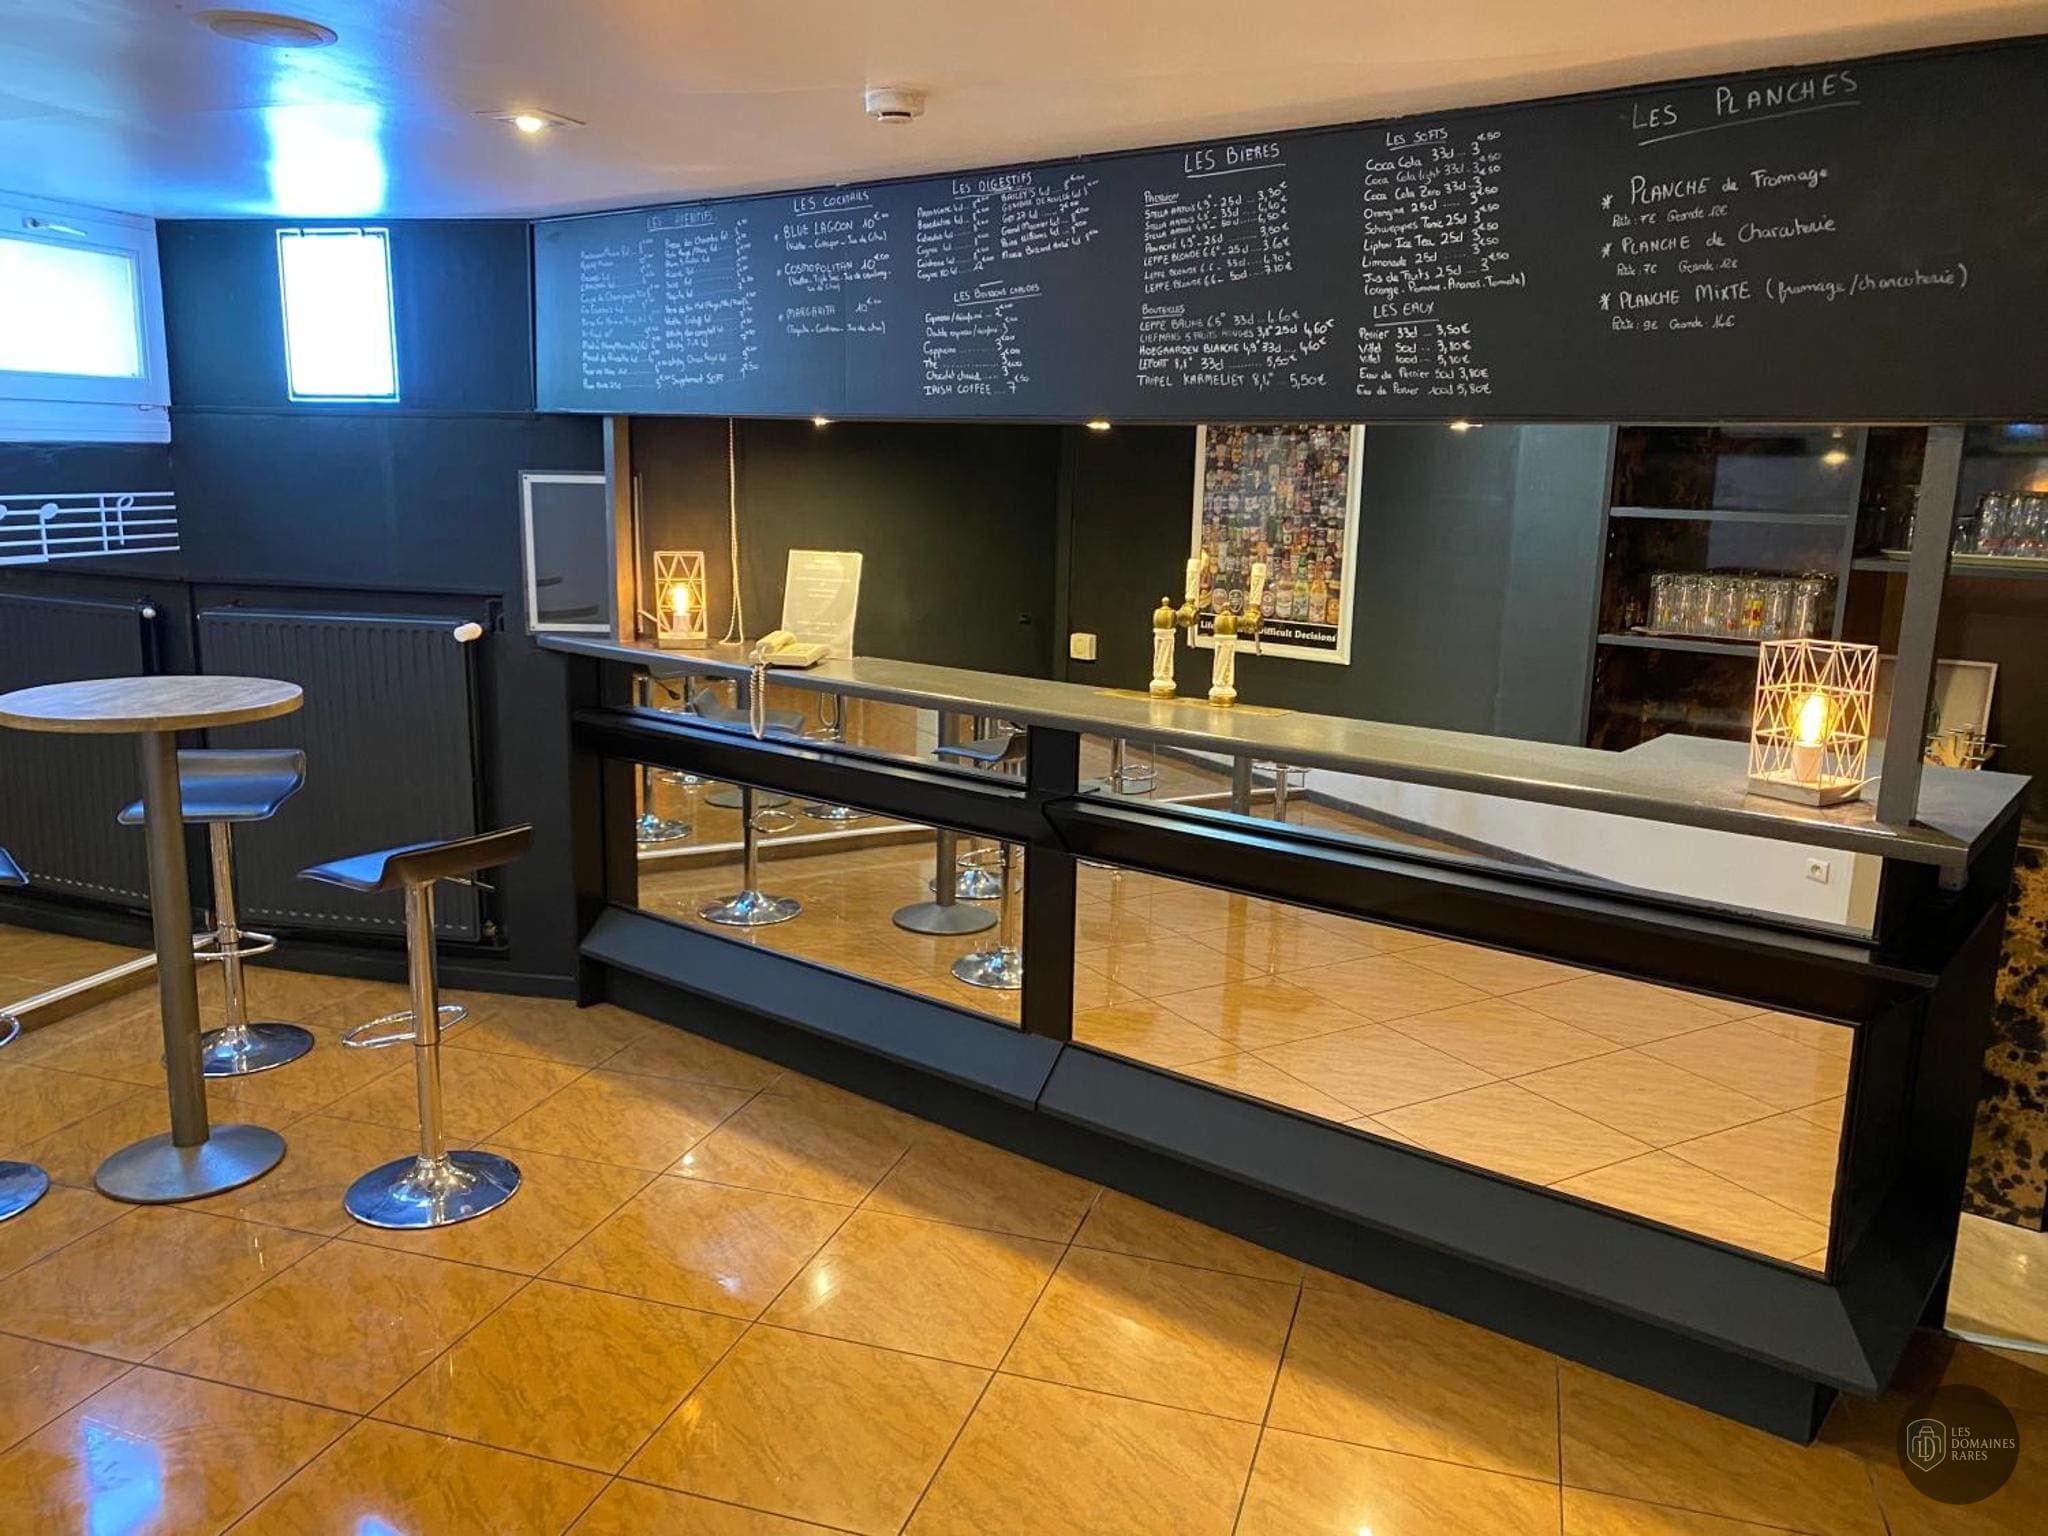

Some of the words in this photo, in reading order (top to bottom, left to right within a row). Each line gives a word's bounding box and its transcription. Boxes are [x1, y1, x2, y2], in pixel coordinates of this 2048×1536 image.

[1632, 103, 1678, 129] LES
[1716, 71, 1858, 115] PLANCHES
[1386, 132, 1405, 146] LES
[1413, 128, 1448, 142] SOFTS
[1184, 150, 1215, 173] LES
[1366, 159, 1396, 172] Coca
[1398, 156, 1422, 168] Cola
[1365, 174, 1390, 186] Coca
[1396, 171, 1417, 182] Cola
[1419, 167, 1441, 184] light
[952, 179, 971, 195] LES
[1363, 189, 1388, 202] Coca
[1395, 187, 1415, 200] Cola
[1631, 175, 1710, 205] PLANCHE
[1722, 178, 1739, 192] de
[1751, 168, 1829, 189] Fromage
[794, 197, 816, 212] LES
[783, 224, 809, 239] BLUE
[814, 220, 853, 236] LAGOON
[1621, 235, 1691, 255] PLANCHE
[1706, 231, 1726, 247] de
[1738, 215, 1837, 244] Charcuterie
[1414, 235, 1435, 247] Tea
[954, 291, 970, 302] LES
[1620, 290, 1680, 310] PLANCHE
[1373, 302, 1398, 319] LES
[1183, 373, 1246, 386] KARMELIET
[1294, 631, 1337, 643] Decisions
